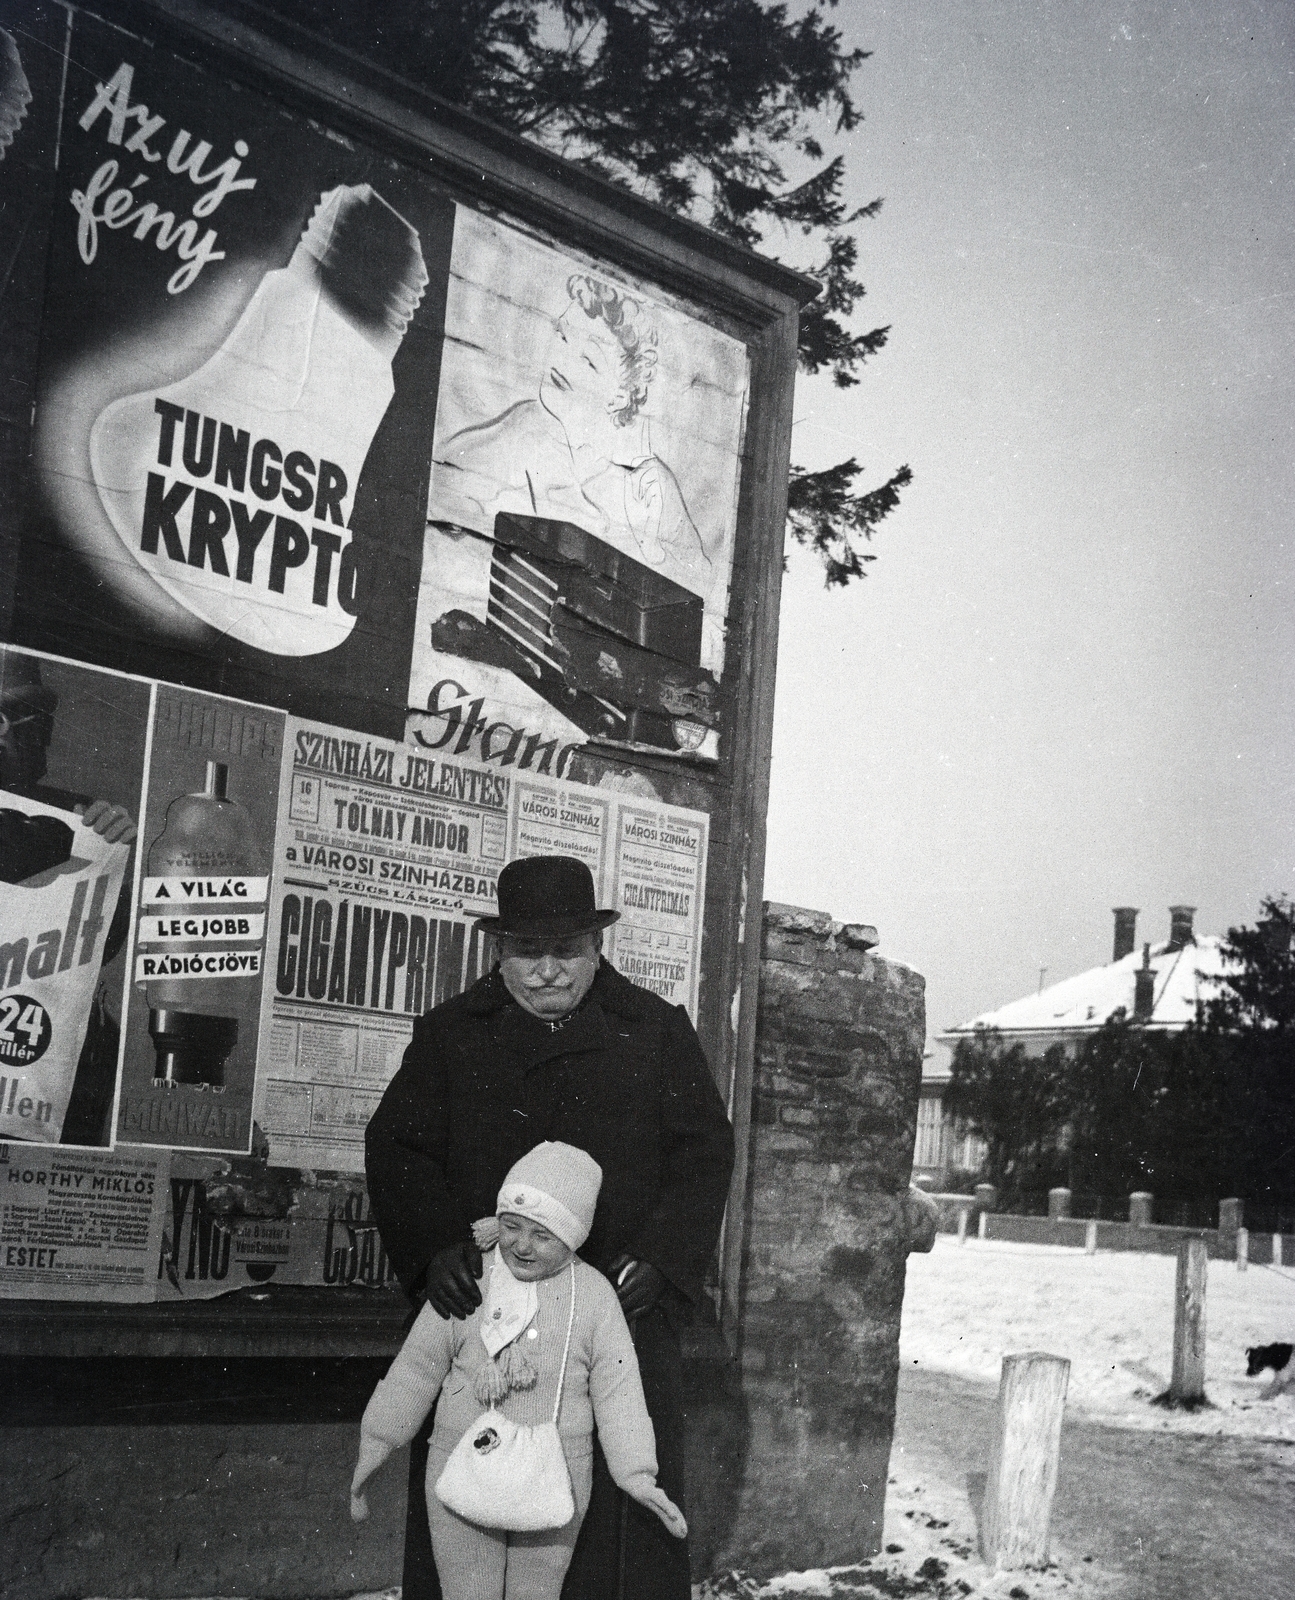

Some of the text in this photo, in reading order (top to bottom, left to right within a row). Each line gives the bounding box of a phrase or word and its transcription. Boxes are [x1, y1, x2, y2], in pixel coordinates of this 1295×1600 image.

[70, 160, 225, 294] fény
[301, 780, 312, 796] 16
[334, 798, 407, 841] TOLNAY
[411, 816, 469, 854] ANDOR
[286, 846, 297, 861] a
[303, 845, 374, 876] VÁROSI
[155, 879, 248, 898] A VILÁG
[393, 891, 464, 909] LÁSZLÓ
[157, 918, 251, 938] LEGJOBB
[143, 953, 259, 976] RÁDIÓCSÖVE
[0, 997, 45, 1047] 24
[8, 1168, 155, 1195] HORTHY MIKLÓS
[6, 1245, 58, 1269] ESTET
